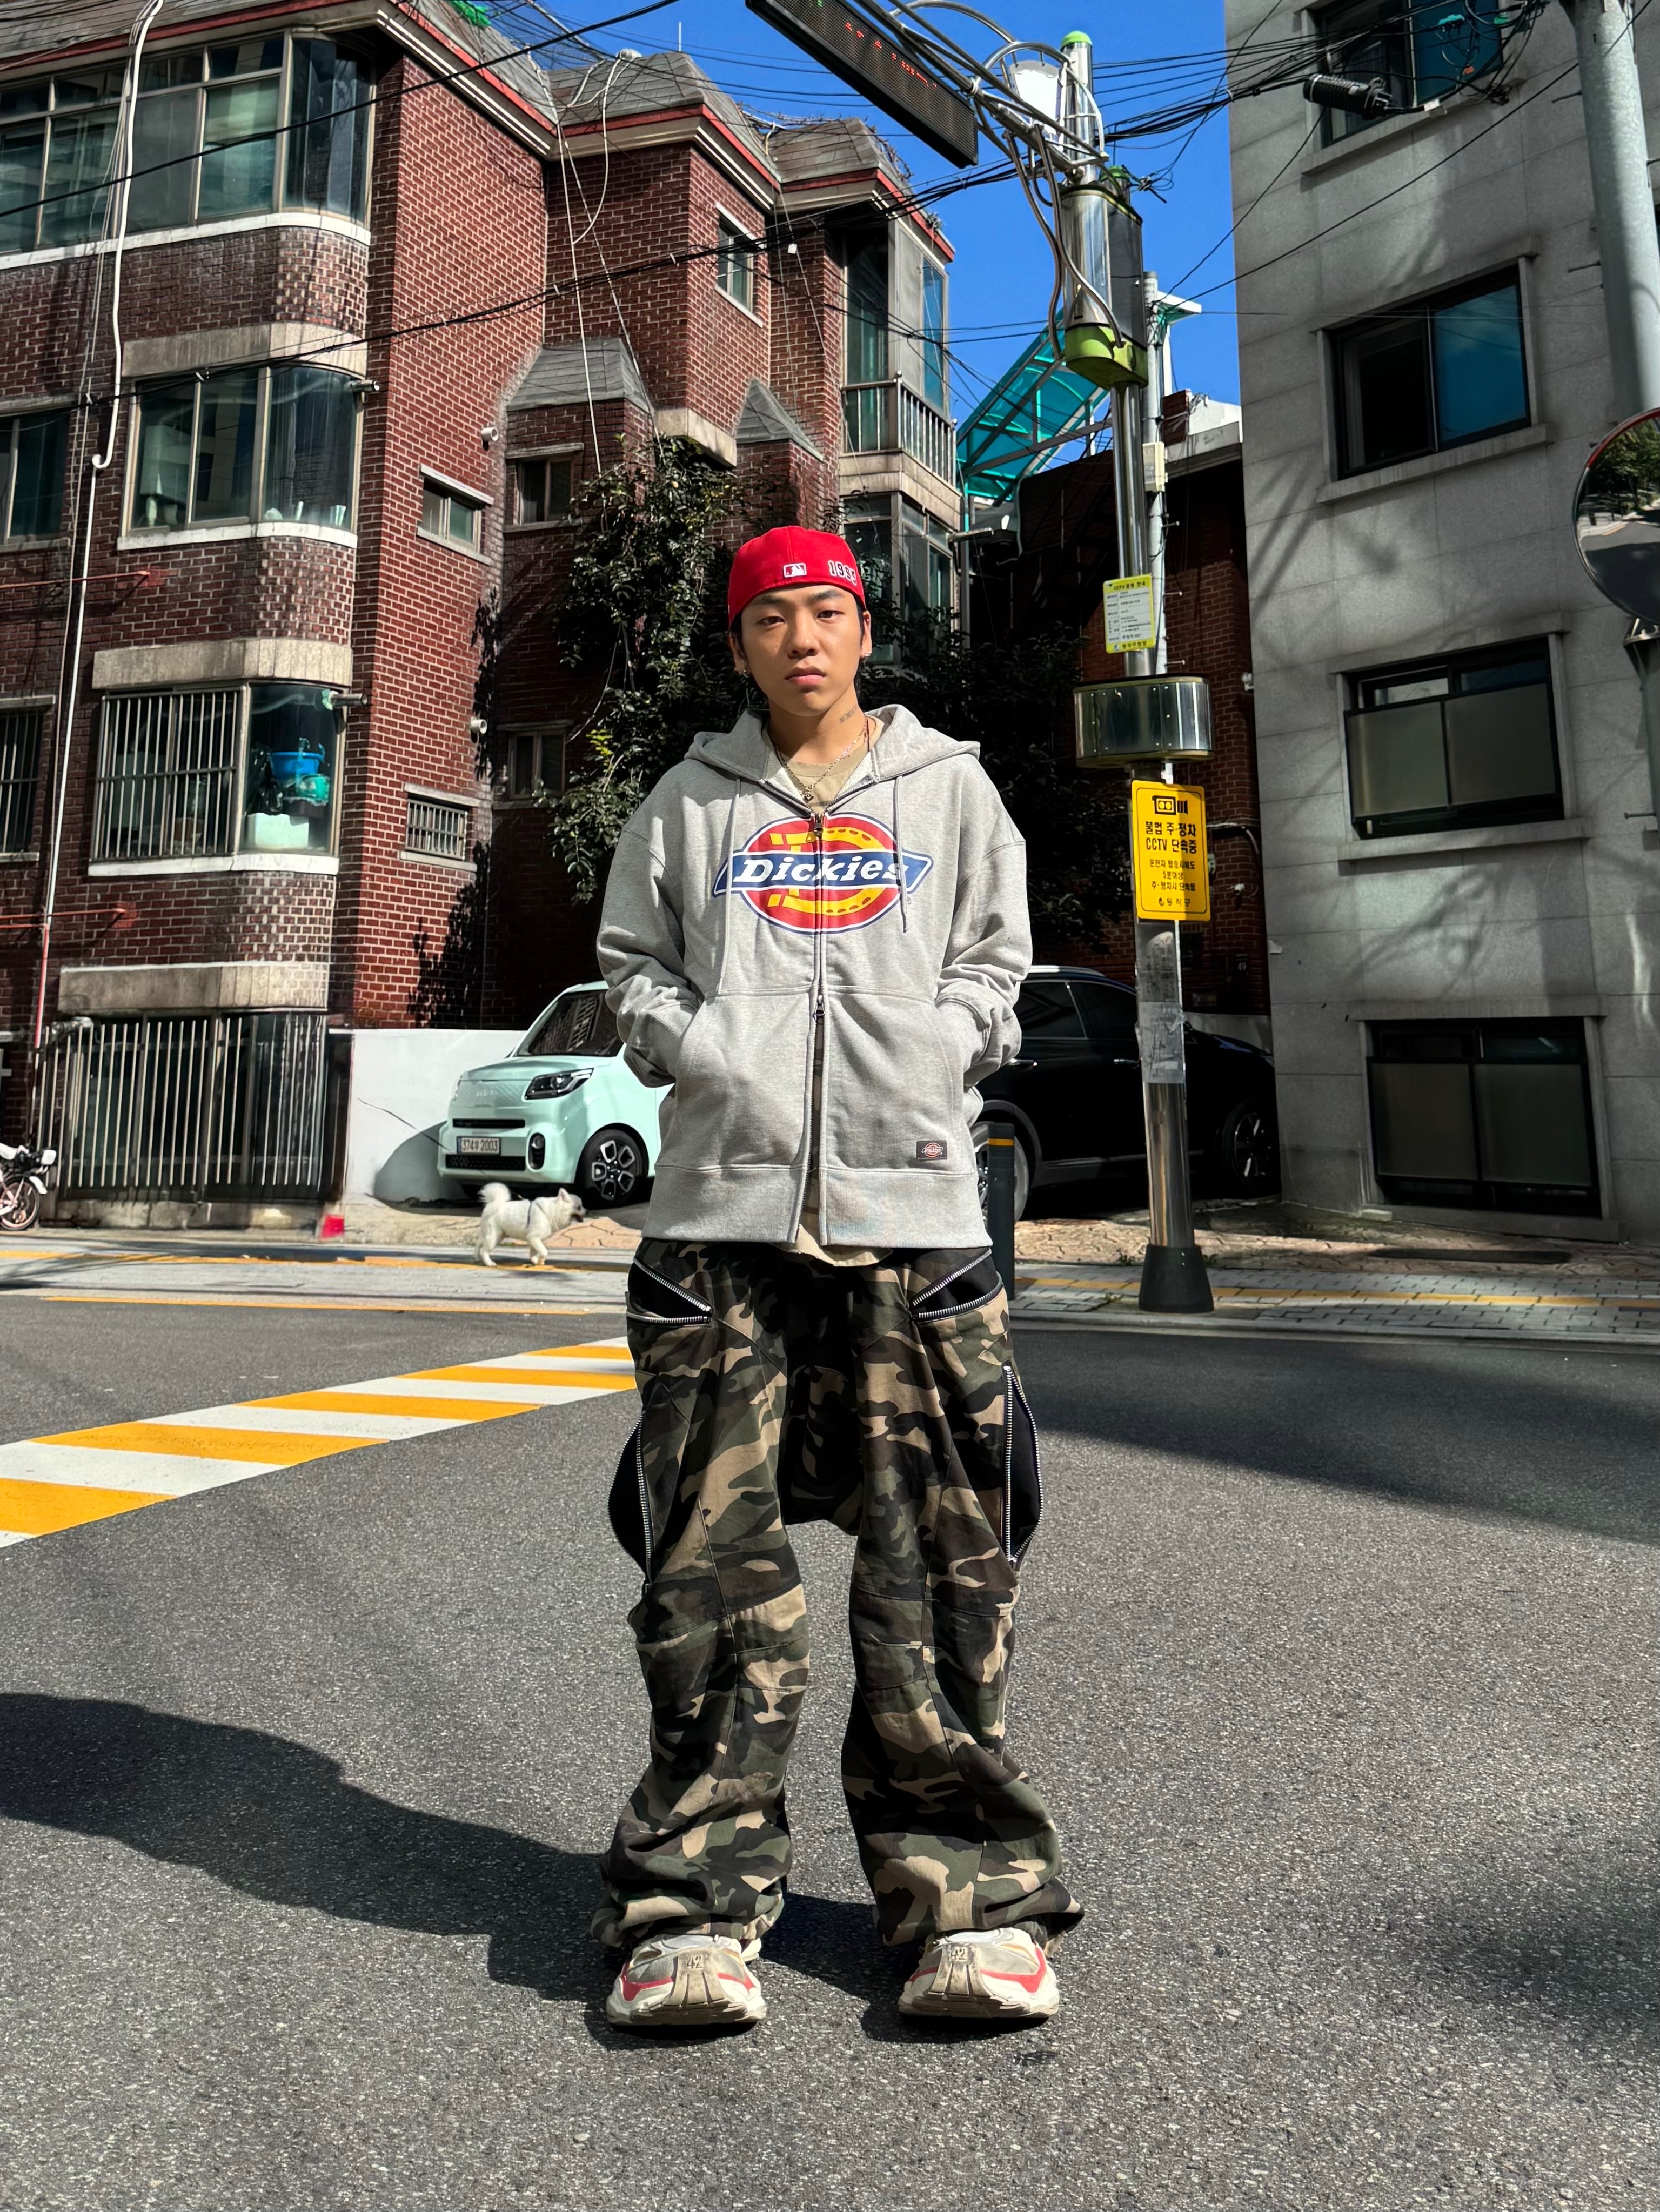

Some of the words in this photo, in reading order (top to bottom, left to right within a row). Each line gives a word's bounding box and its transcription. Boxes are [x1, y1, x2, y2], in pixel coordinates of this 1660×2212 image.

[828, 560, 857, 586] 1995
[1146, 821, 1162, 835] 불법
[1166, 822, 1196, 837] 주·정차
[1146, 837, 1167, 851] CCTV
[1172, 839, 1197, 854] 단속중
[733, 855, 908, 883] Dickies
[1149, 859, 1166, 868] 운전자
[1163, 870, 1183, 880] 5분이상
[1237, 962, 1247, 971] 49
[687, 1954, 704, 1969] 42
[951, 1948, 966, 1960] 42
